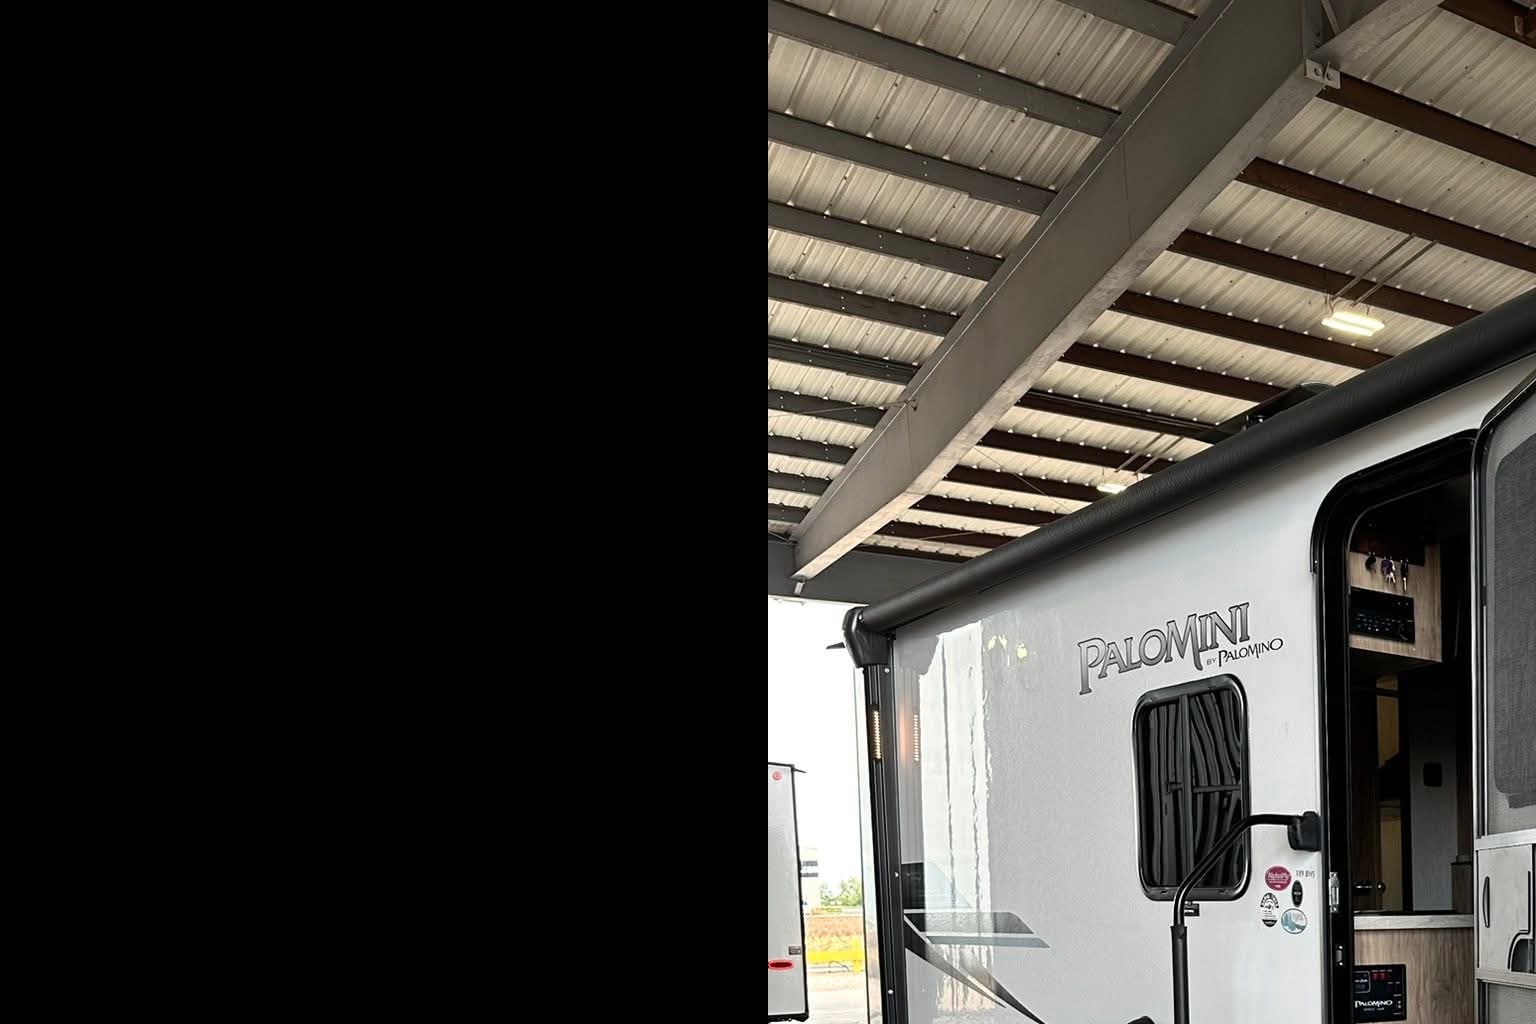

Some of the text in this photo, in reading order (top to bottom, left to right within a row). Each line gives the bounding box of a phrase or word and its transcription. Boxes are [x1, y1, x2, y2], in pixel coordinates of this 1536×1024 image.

[1078, 602, 1250, 695] PALOMINI
[1206, 637, 1283, 667] BY PALOMINO
[1354, 1000, 1393, 1008] PALOMINO
